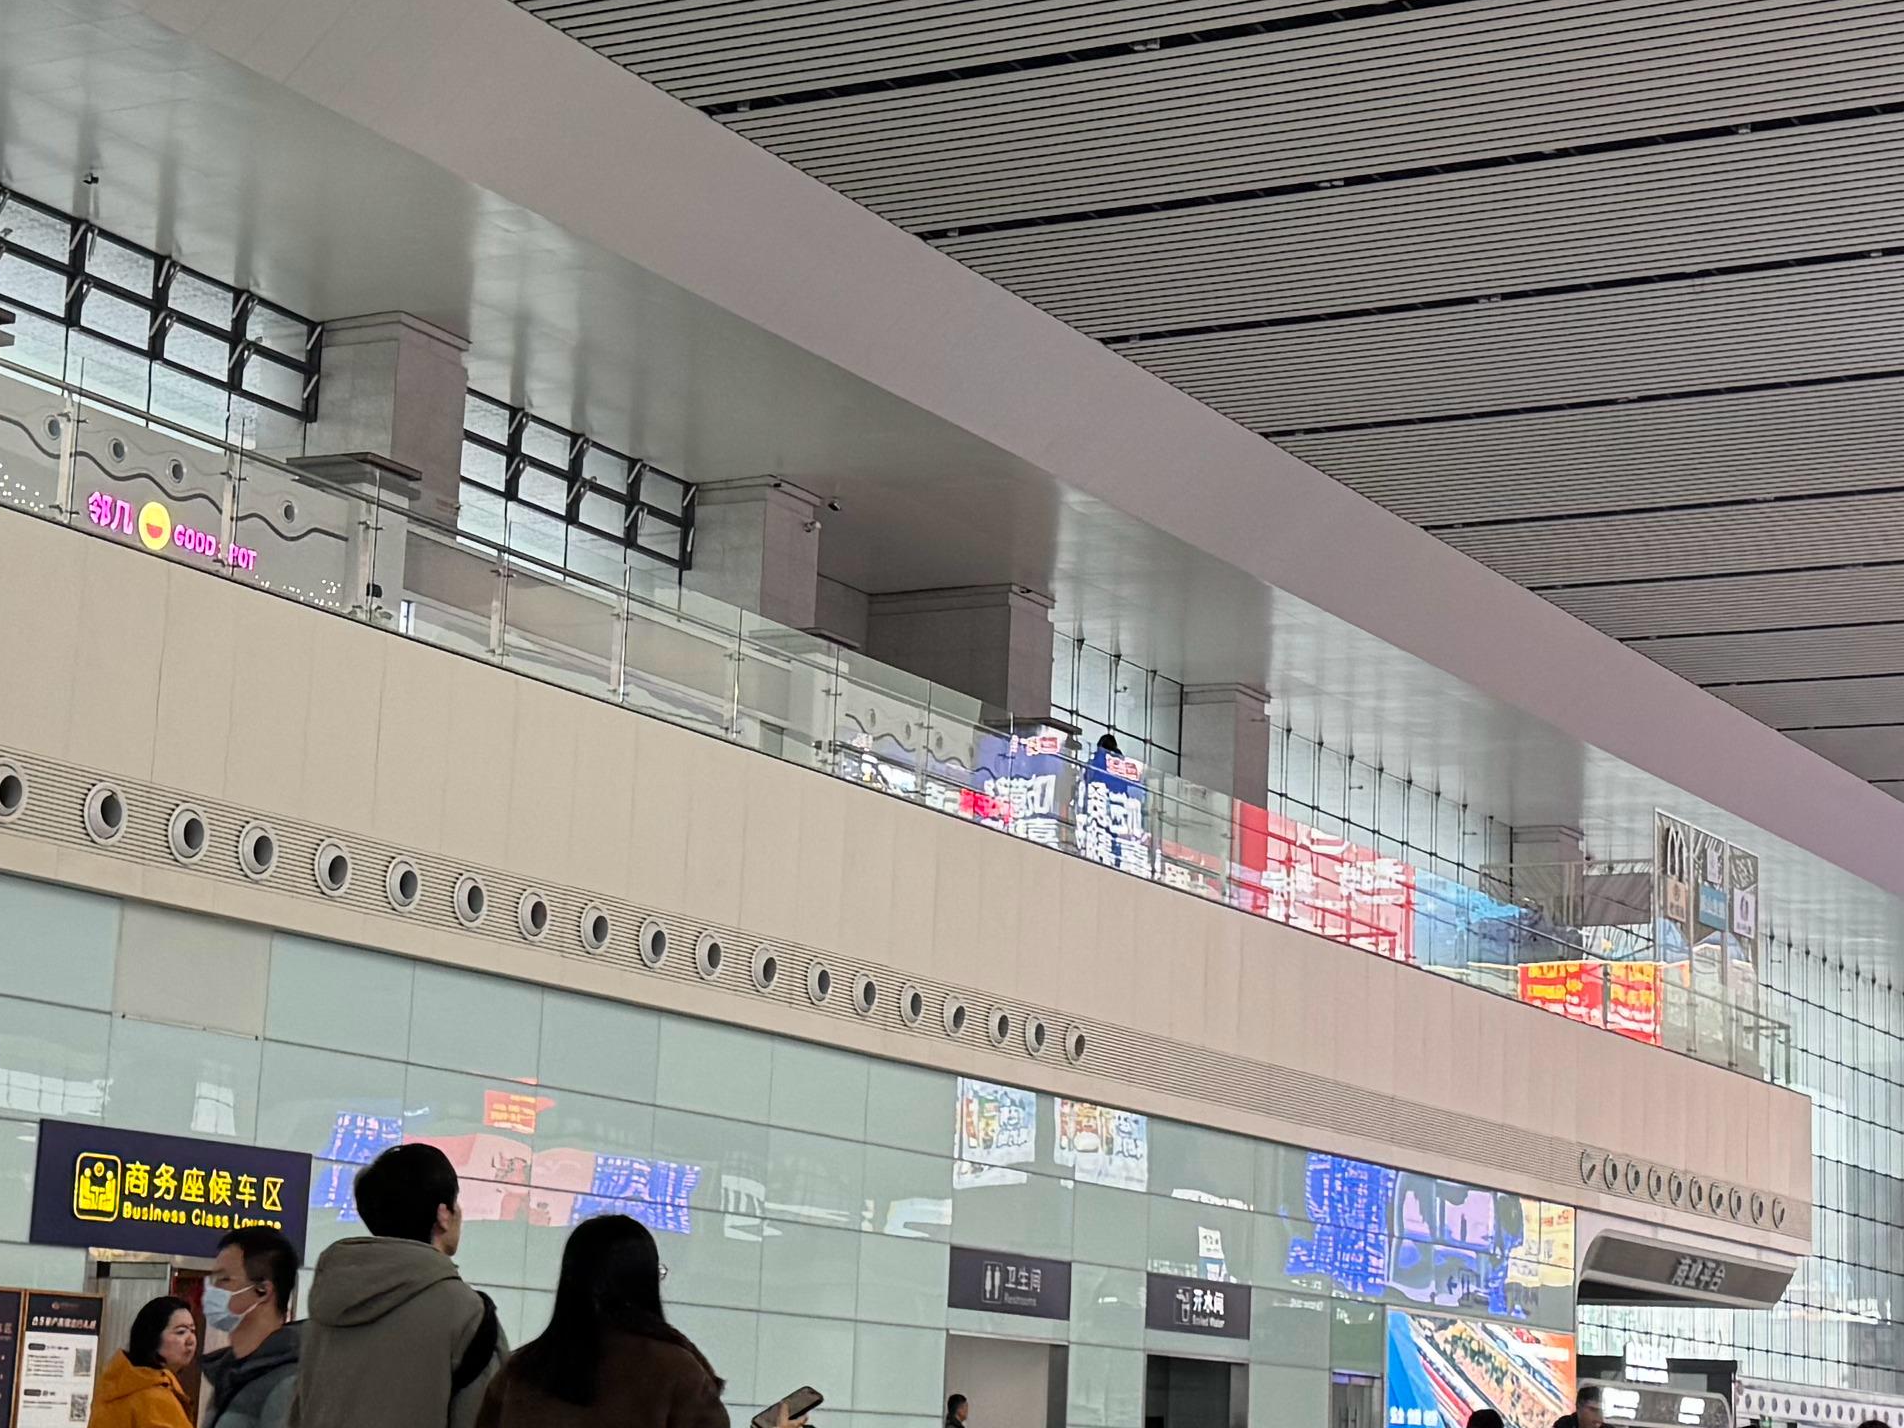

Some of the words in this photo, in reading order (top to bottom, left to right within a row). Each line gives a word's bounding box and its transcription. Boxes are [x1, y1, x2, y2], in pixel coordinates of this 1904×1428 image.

[88, 491, 134, 535] 邻几
[174, 524, 216, 557] GOOD
[218, 541, 258, 571] POT
[124, 1160, 284, 1212] 商务座候车区
[122, 1201, 187, 1225] Business
[191, 1208, 230, 1230] Class
[1005, 1265, 1042, 1292] 卫生间
[1193, 1289, 1224, 1316] 开水间
